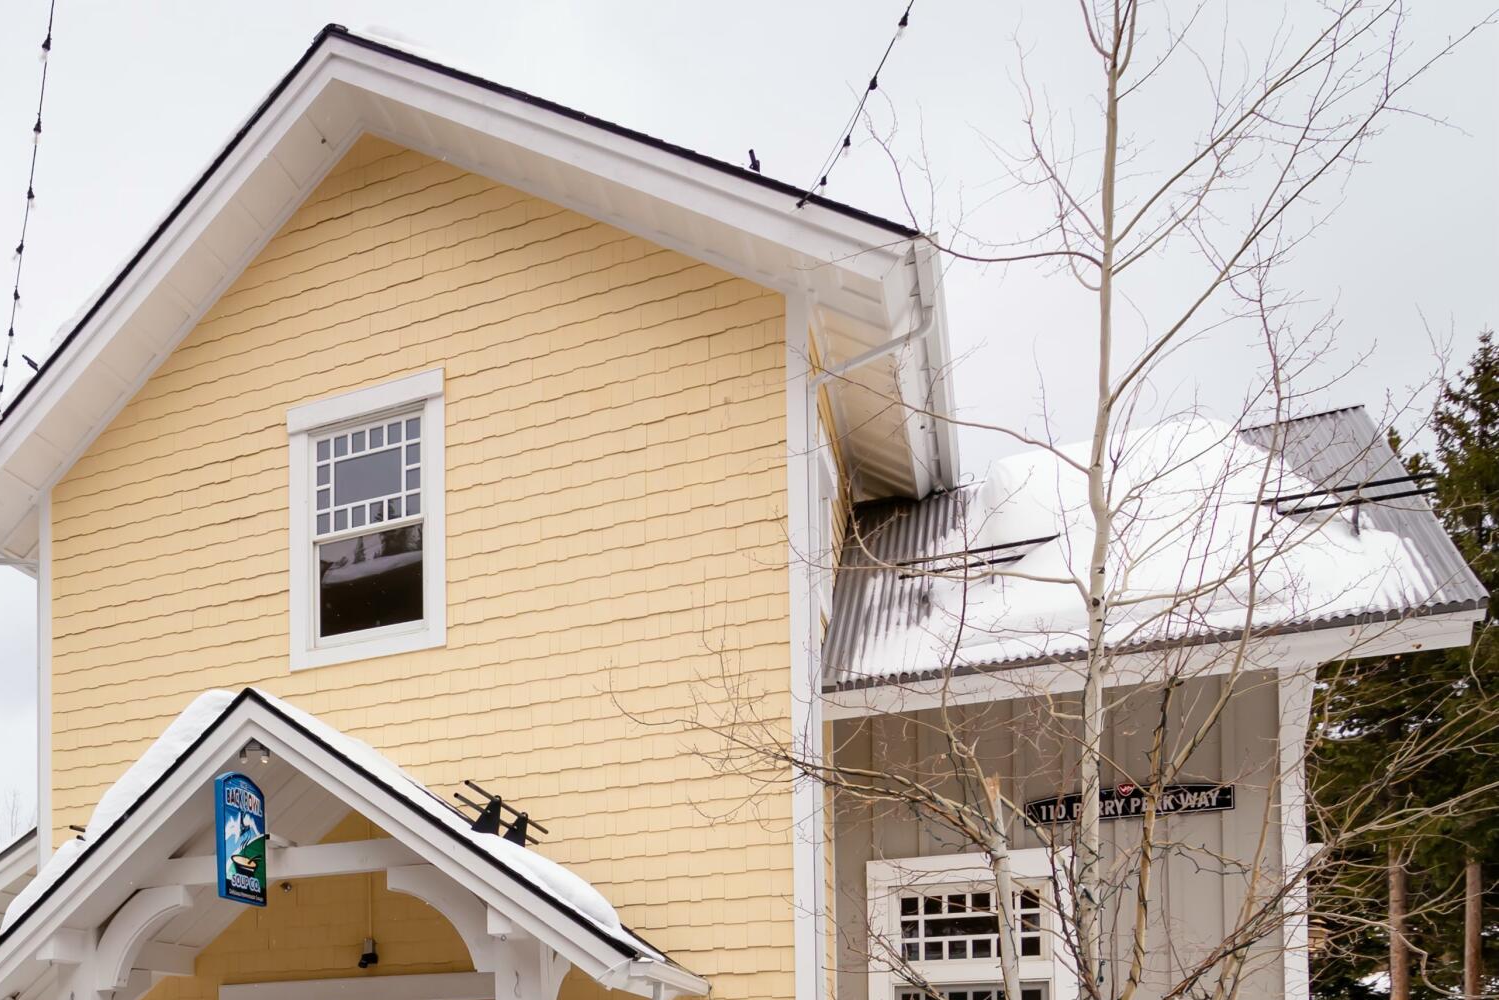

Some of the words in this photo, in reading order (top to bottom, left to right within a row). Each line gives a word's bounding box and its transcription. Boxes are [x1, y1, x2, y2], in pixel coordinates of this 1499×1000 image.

[1041, 803, 1067, 821] 110
[1073, 799, 1125, 819] PRRY
[1130, 794, 1176, 814] PEK
[1180, 790, 1220, 809] WAY
